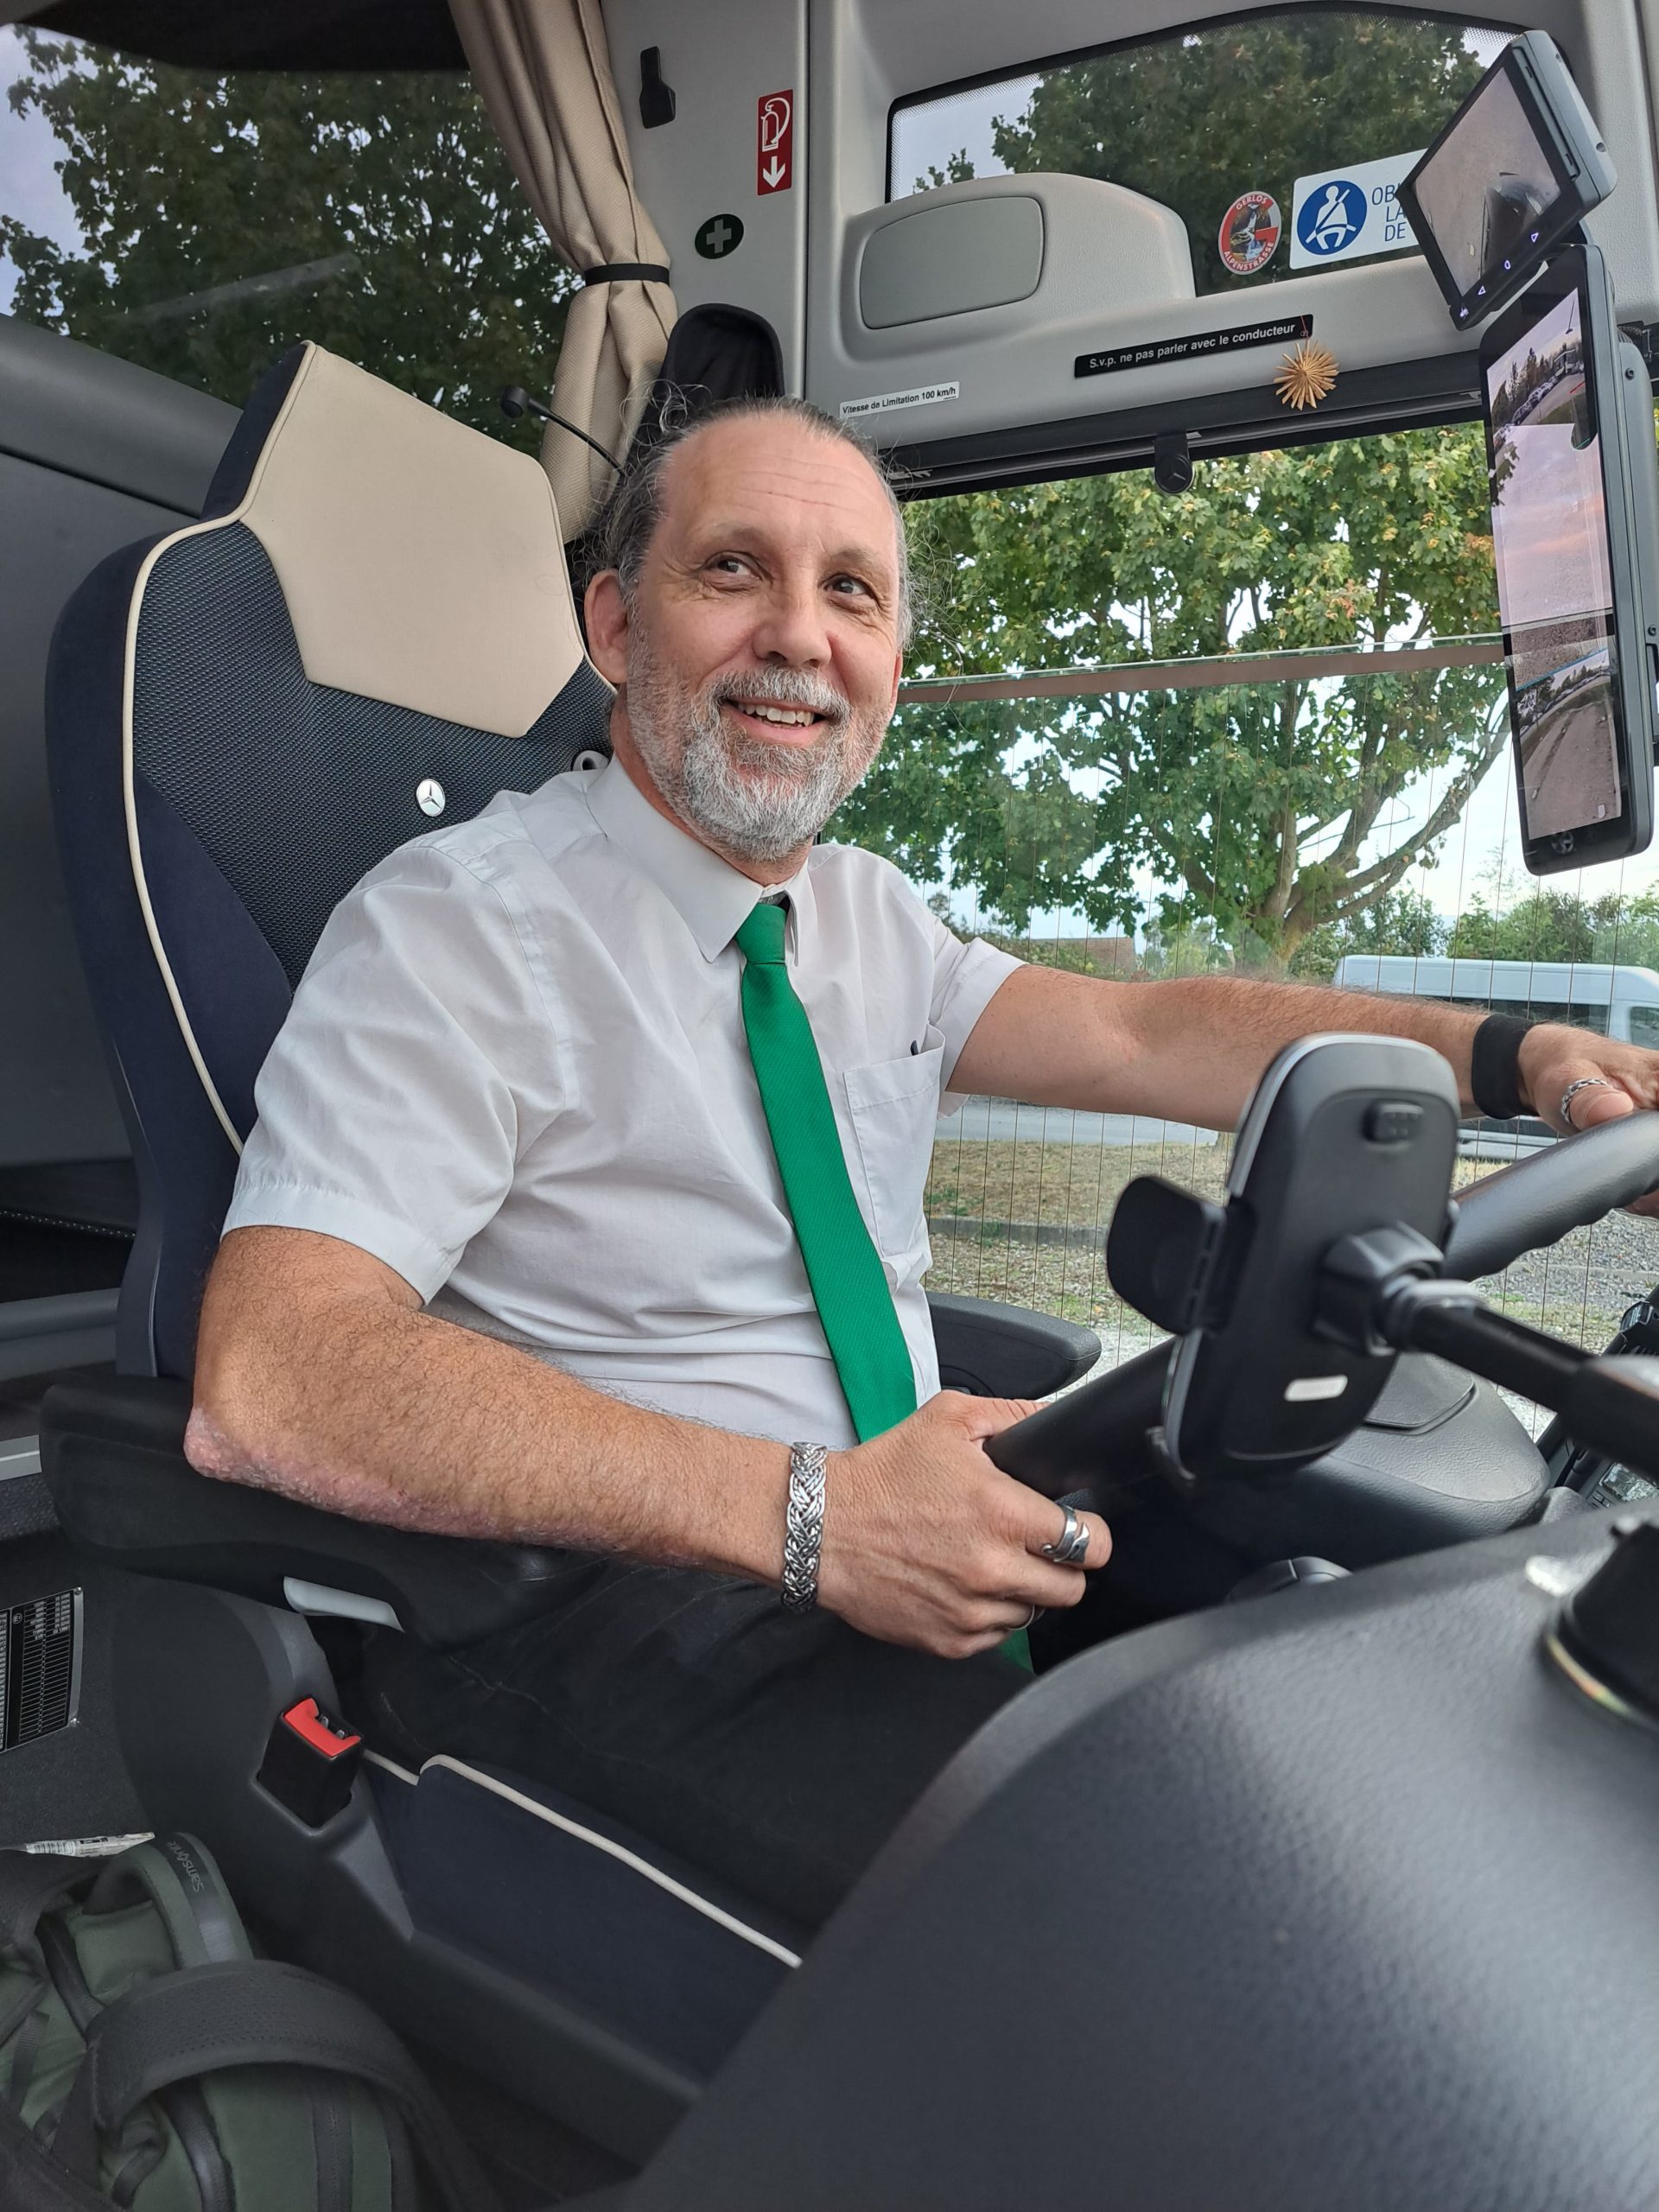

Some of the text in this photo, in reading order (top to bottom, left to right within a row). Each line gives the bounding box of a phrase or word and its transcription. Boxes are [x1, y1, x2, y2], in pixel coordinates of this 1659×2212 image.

[1236, 194, 1268, 210] GERLOS
[1371, 182, 1401, 206] OB
[1386, 205, 1407, 222] LA
[1384, 221, 1407, 242] DE
[1224, 241, 1274, 271] ALPENSTRASSE
[1089, 324, 1296, 368] S.v.p. ne pas parler avec le conducteur
[842, 402, 869, 414] Vitesse
[882, 393, 919, 408] Limitation
[922, 391, 935, 400] 100
[937, 386, 957, 397] km/h
